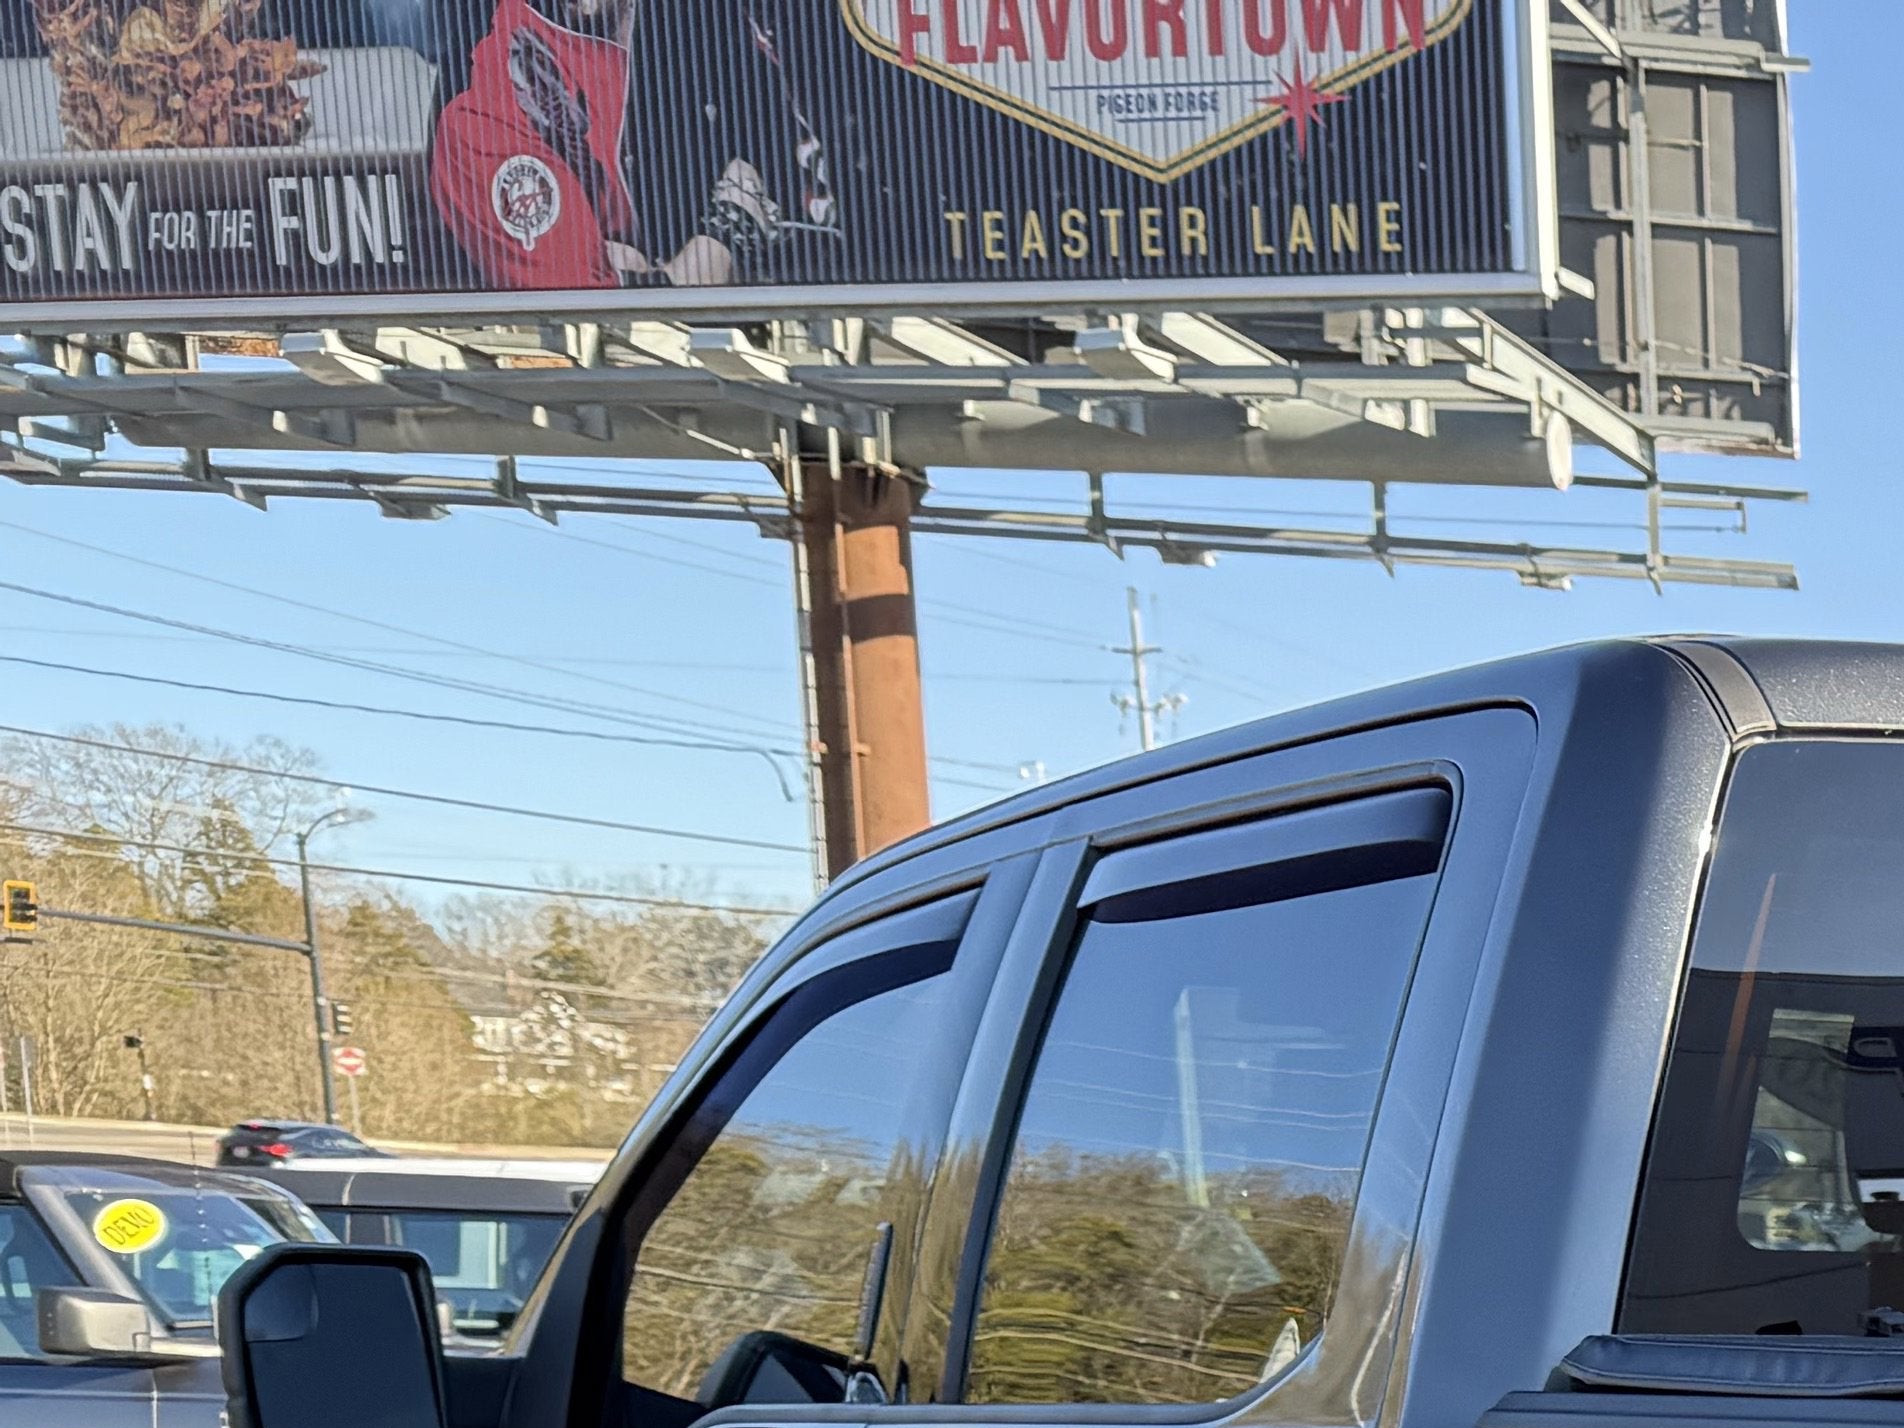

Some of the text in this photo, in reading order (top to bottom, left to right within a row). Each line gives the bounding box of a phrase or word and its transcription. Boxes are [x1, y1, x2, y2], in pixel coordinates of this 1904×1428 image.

[1096, 90, 1219, 115] PIGEON FORGE
[1, 174, 404, 272] STAY FOR THE FUN!
[944, 201, 1403, 260] TEASTER LANE
